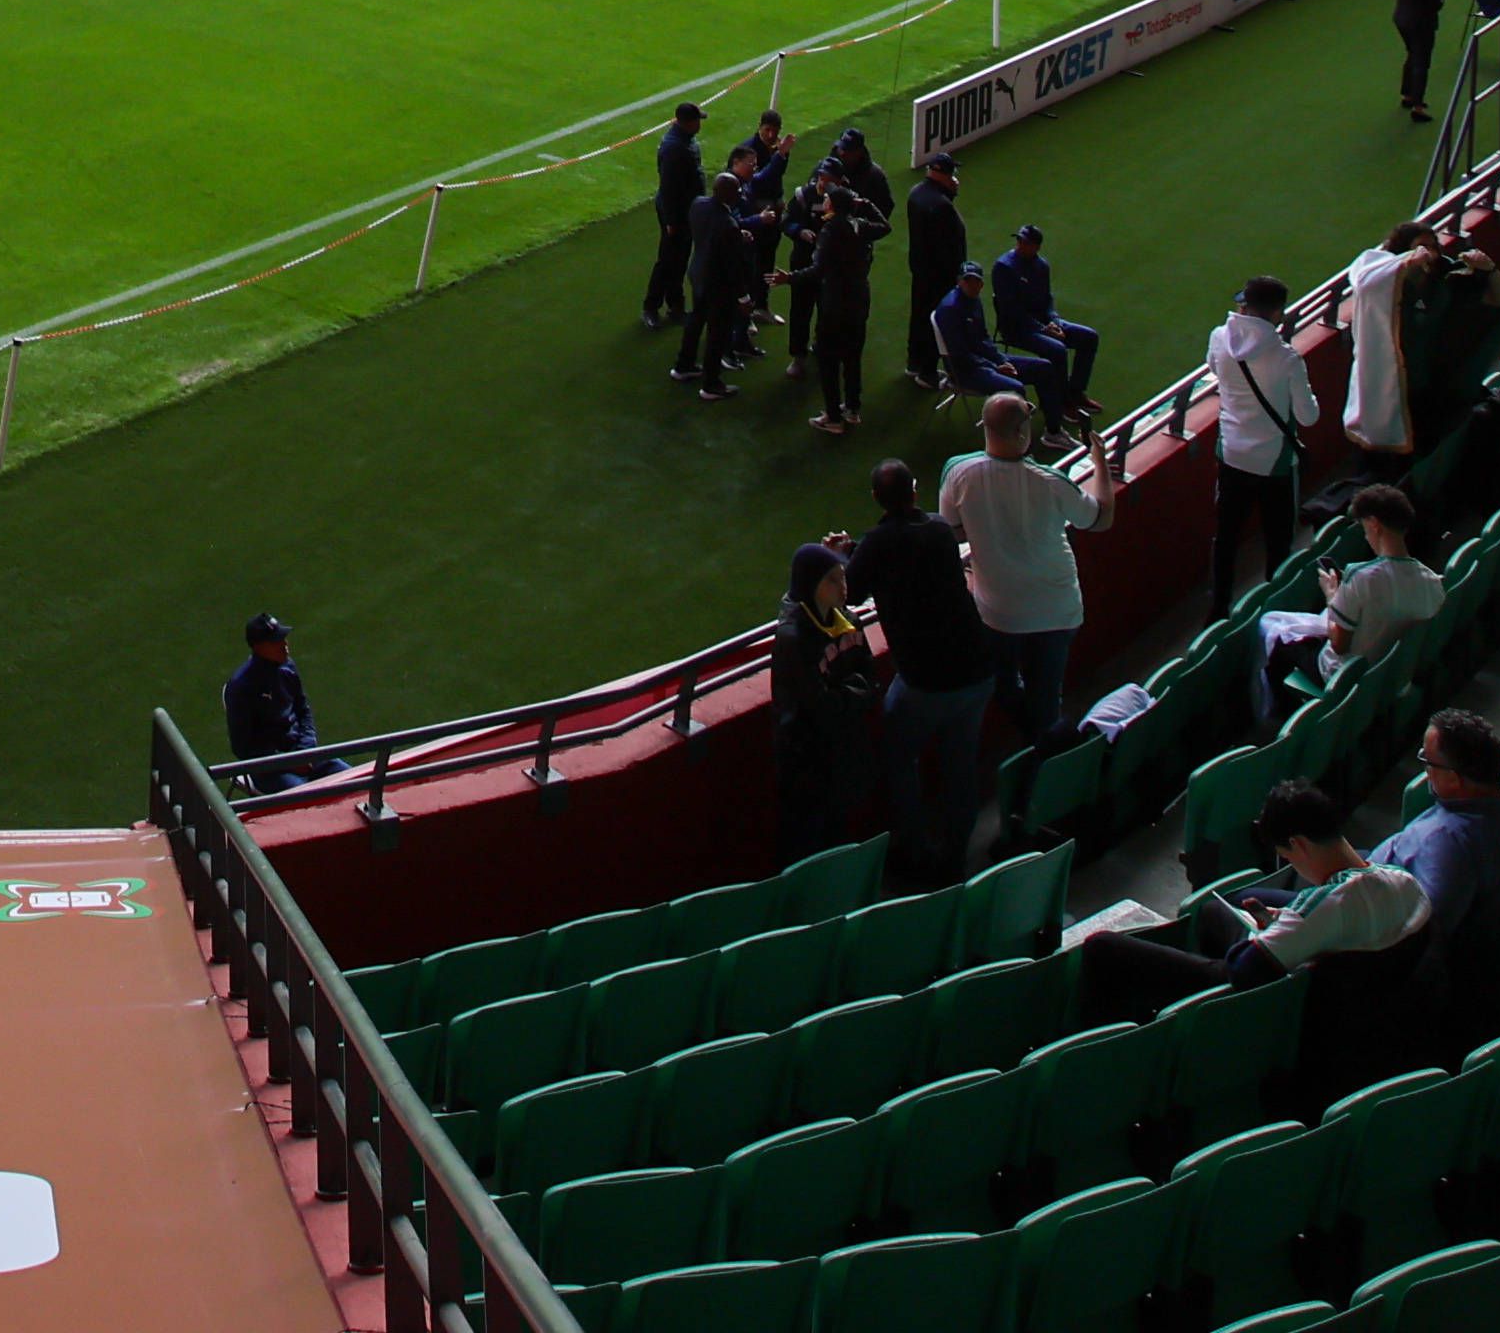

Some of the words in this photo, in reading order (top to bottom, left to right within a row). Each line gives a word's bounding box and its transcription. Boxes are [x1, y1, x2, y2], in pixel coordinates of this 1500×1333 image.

[1145, 1, 1203, 39] TotalEnergies
[1034, 29, 1113, 100] 1XBET
[924, 80, 993, 153] PUMA
